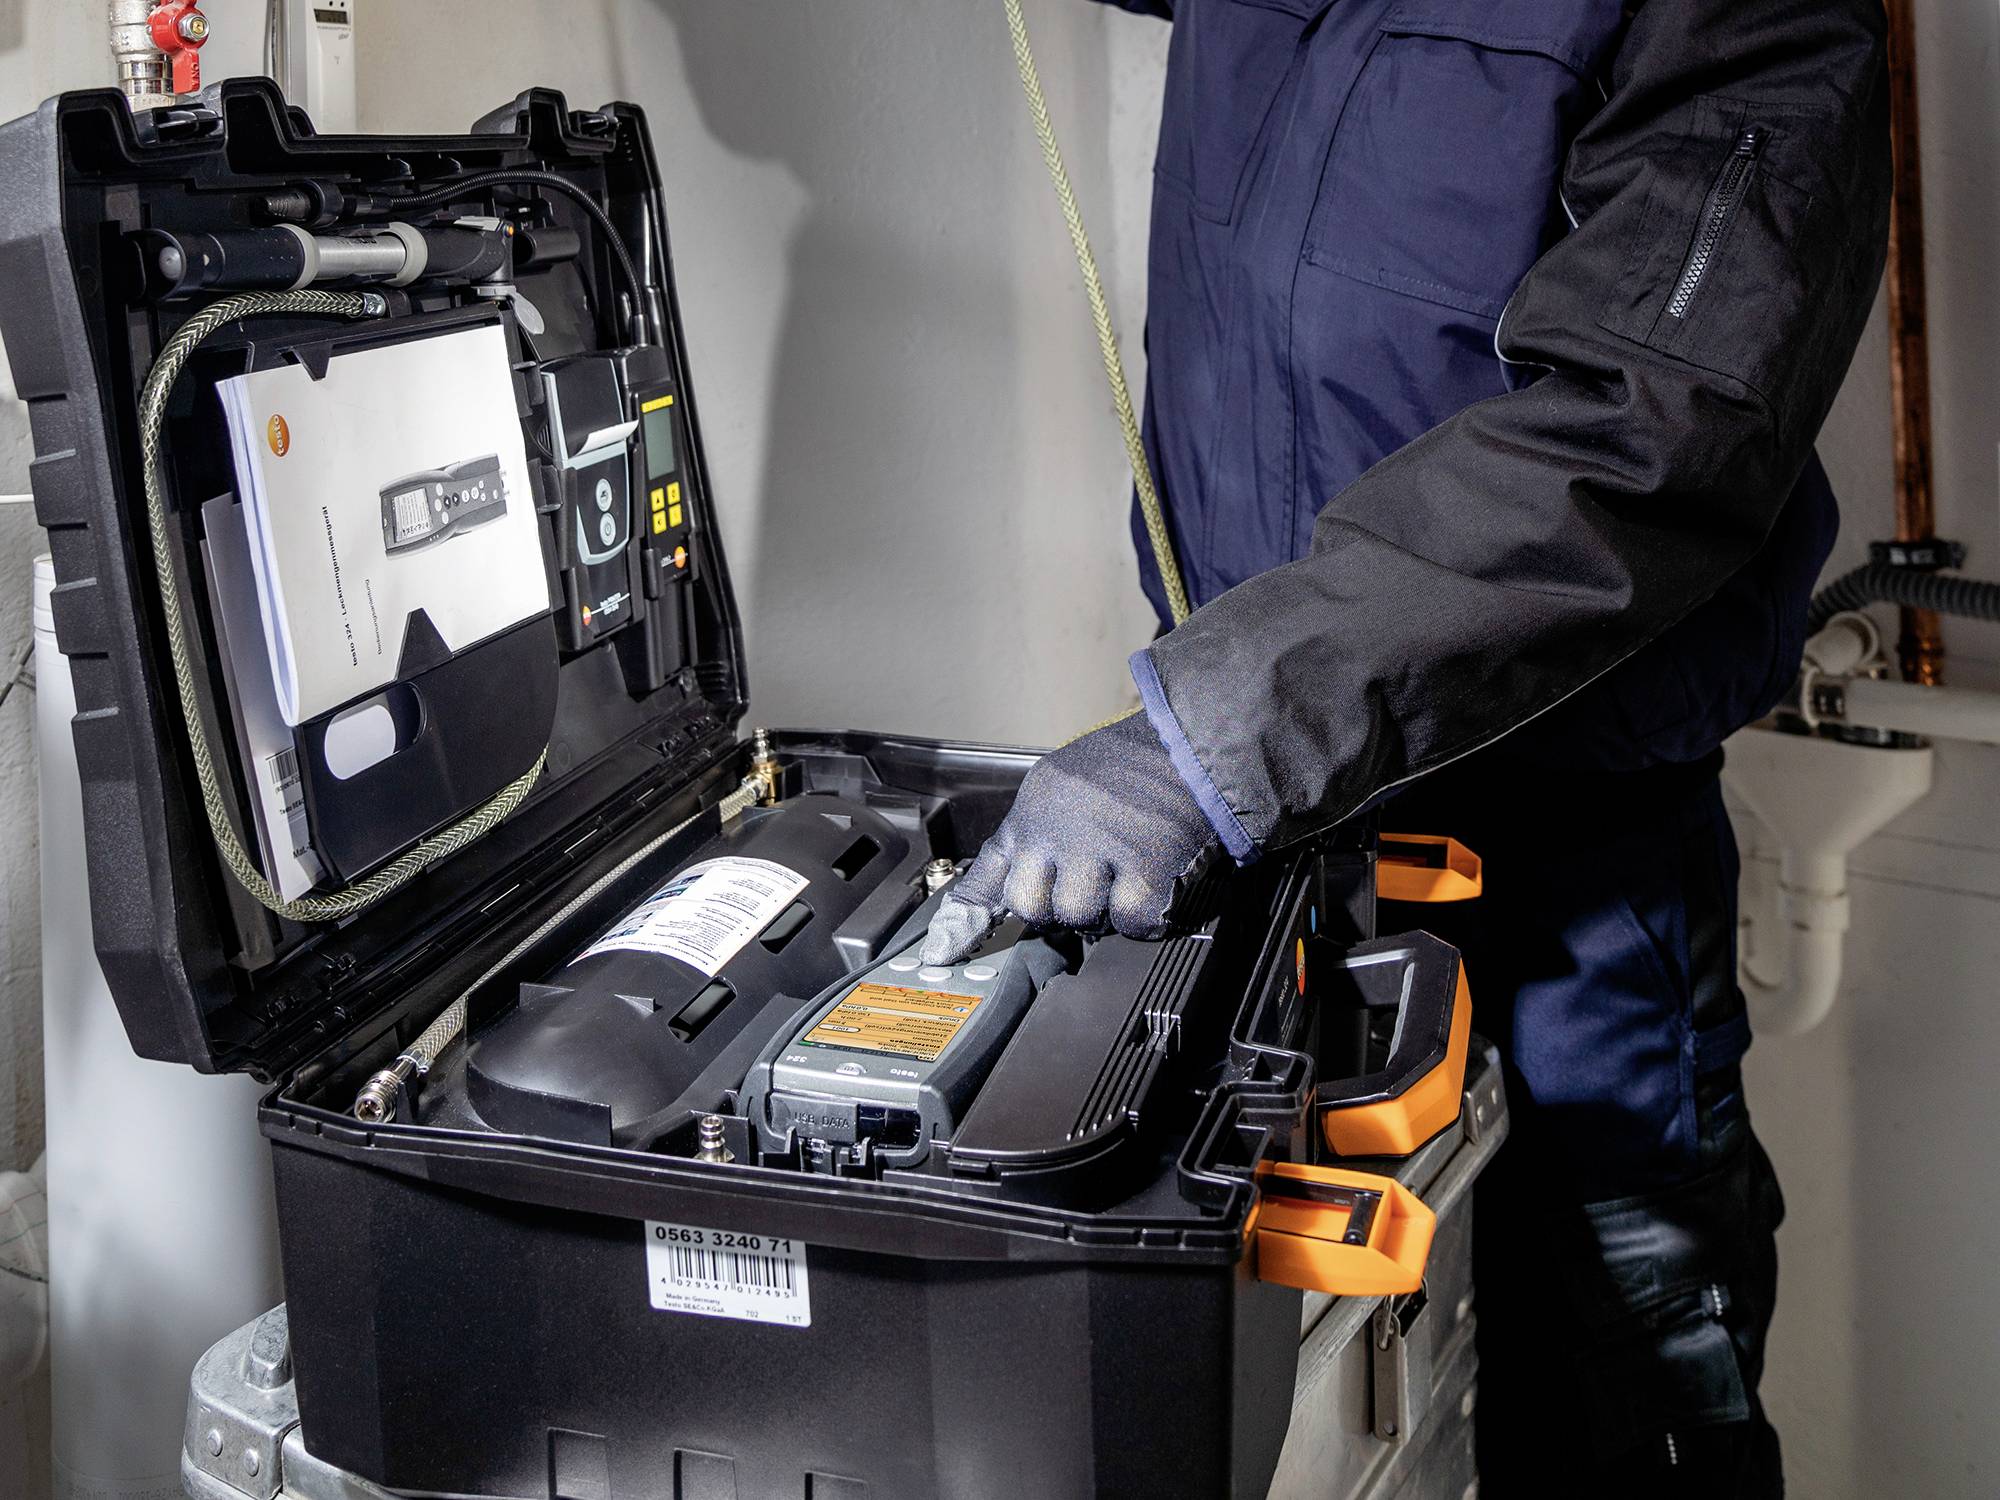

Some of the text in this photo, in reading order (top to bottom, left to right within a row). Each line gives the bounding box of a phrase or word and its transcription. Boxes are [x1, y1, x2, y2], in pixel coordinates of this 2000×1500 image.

[272, 415, 286, 455] testo
[344, 622, 353, 639] 324
[349, 642, 358, 668] testo
[786, 1054, 919, 1079] testo 324
[794, 1111, 850, 1130] USB DATA
[655, 1226, 791, 1254] 0563 3240 71
[664, 1300, 682, 1309] Testo
[666, 1292, 683, 1301] Made
[692, 1295, 721, 1306] Germany
[746, 1309, 759, 1318] 702
